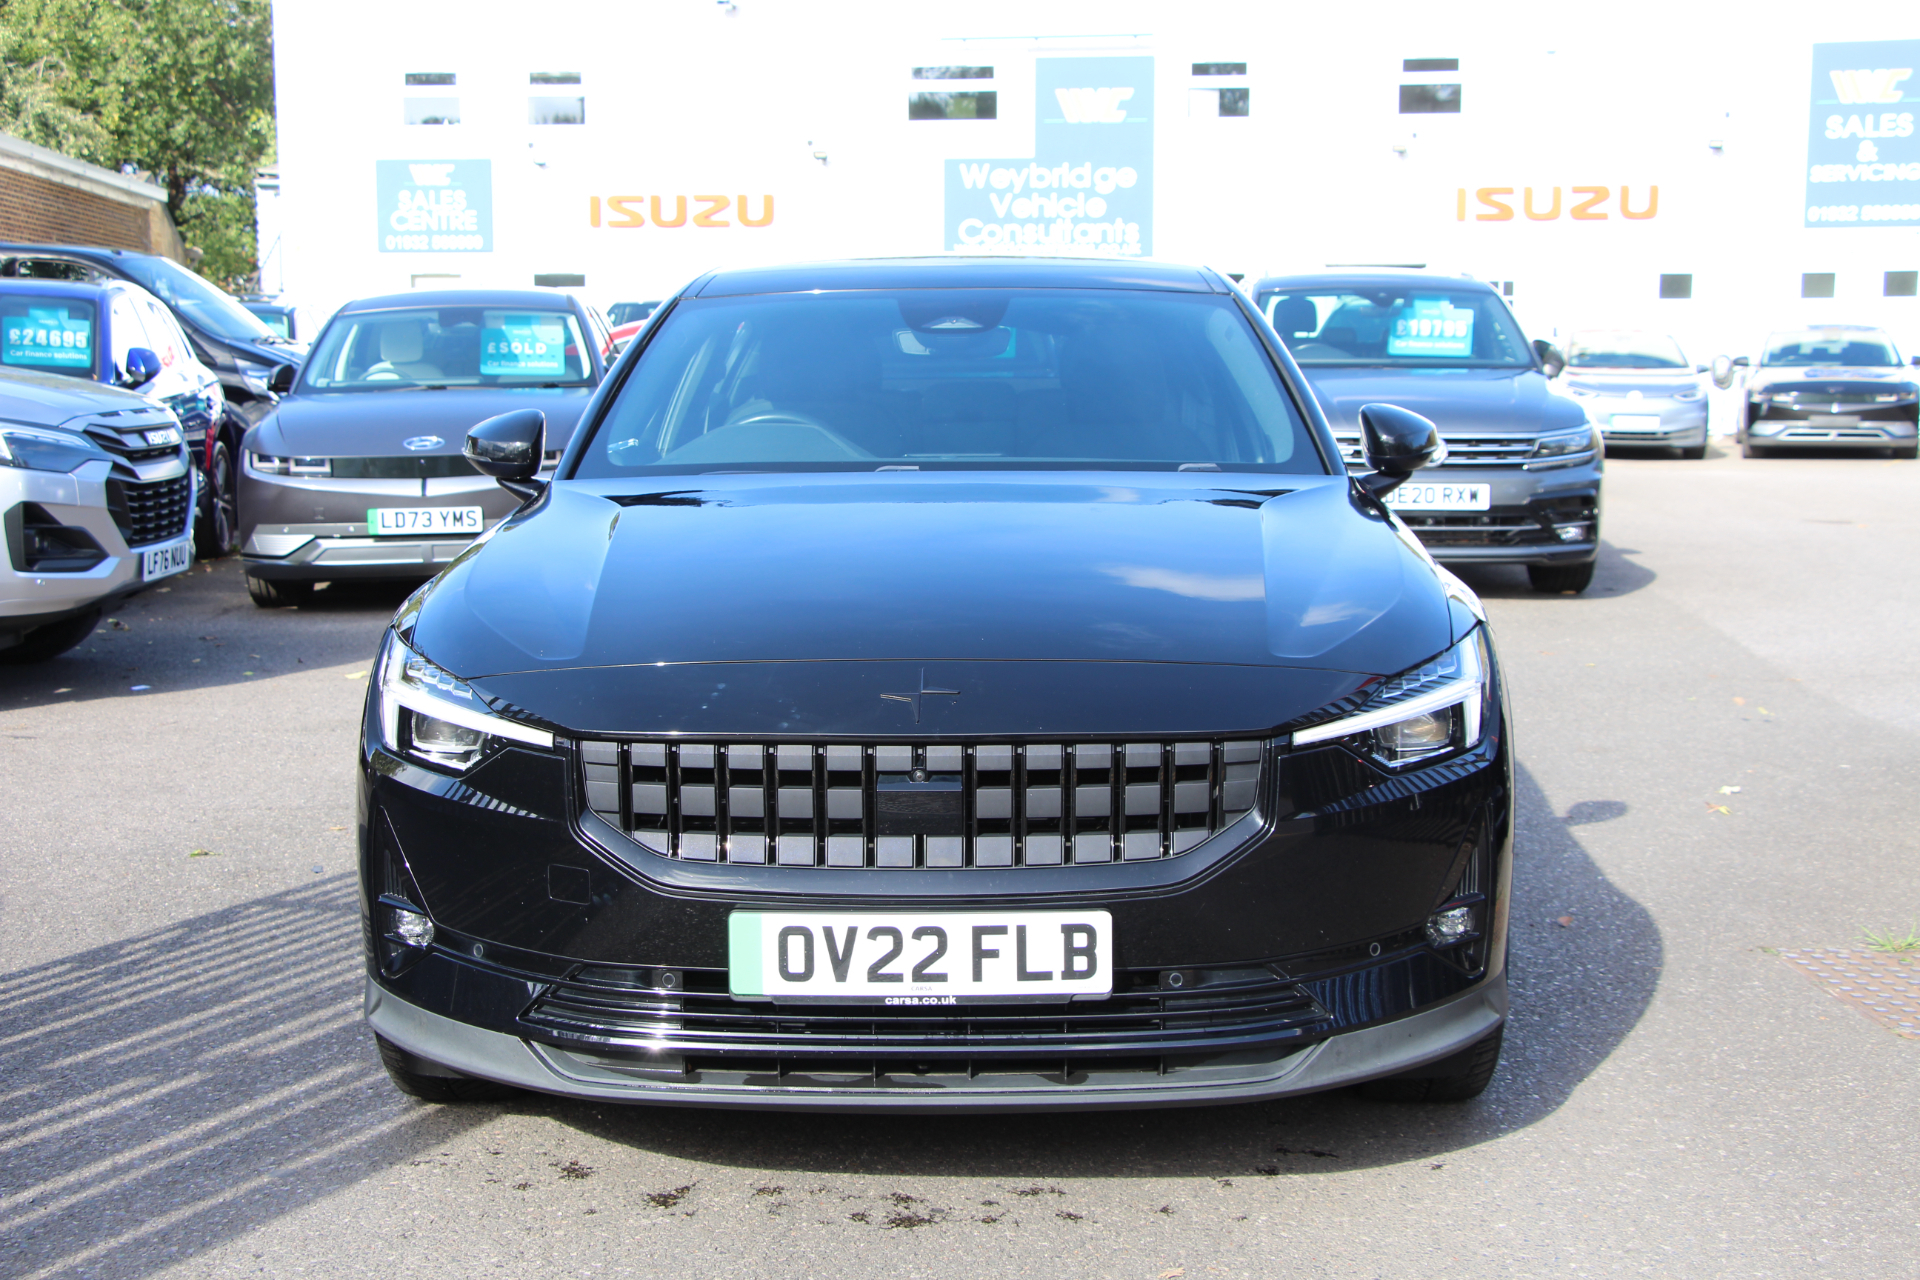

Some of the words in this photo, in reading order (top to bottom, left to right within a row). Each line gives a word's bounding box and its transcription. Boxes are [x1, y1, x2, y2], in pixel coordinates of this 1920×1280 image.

[1824, 112, 1914, 139] SALES
[1856, 139, 1878, 163] &
[959, 162, 1138, 195] Weybridge
[1809, 162, 1920, 183] SERVICING
[398, 189, 467, 211] SALES
[590, 194, 774, 228] ISUZU
[989, 191, 1107, 219] Vehicle
[1457, 185, 1659, 222] ISUZU
[390, 209, 478, 231] CENTRE
[958, 217, 1140, 245] Consultants
[9, 328, 88, 349] £24695
[25, 350, 52, 358] finance
[54, 352, 87, 360] solutions
[1443, 487, 1479, 504] RXW
[381, 511, 432, 528] LD73
[440, 510, 477, 528] YMS
[778, 925, 948, 983] OV22
[972, 923, 1097, 982] FLB
[884, 995, 957, 1005] carsa.co.uk
